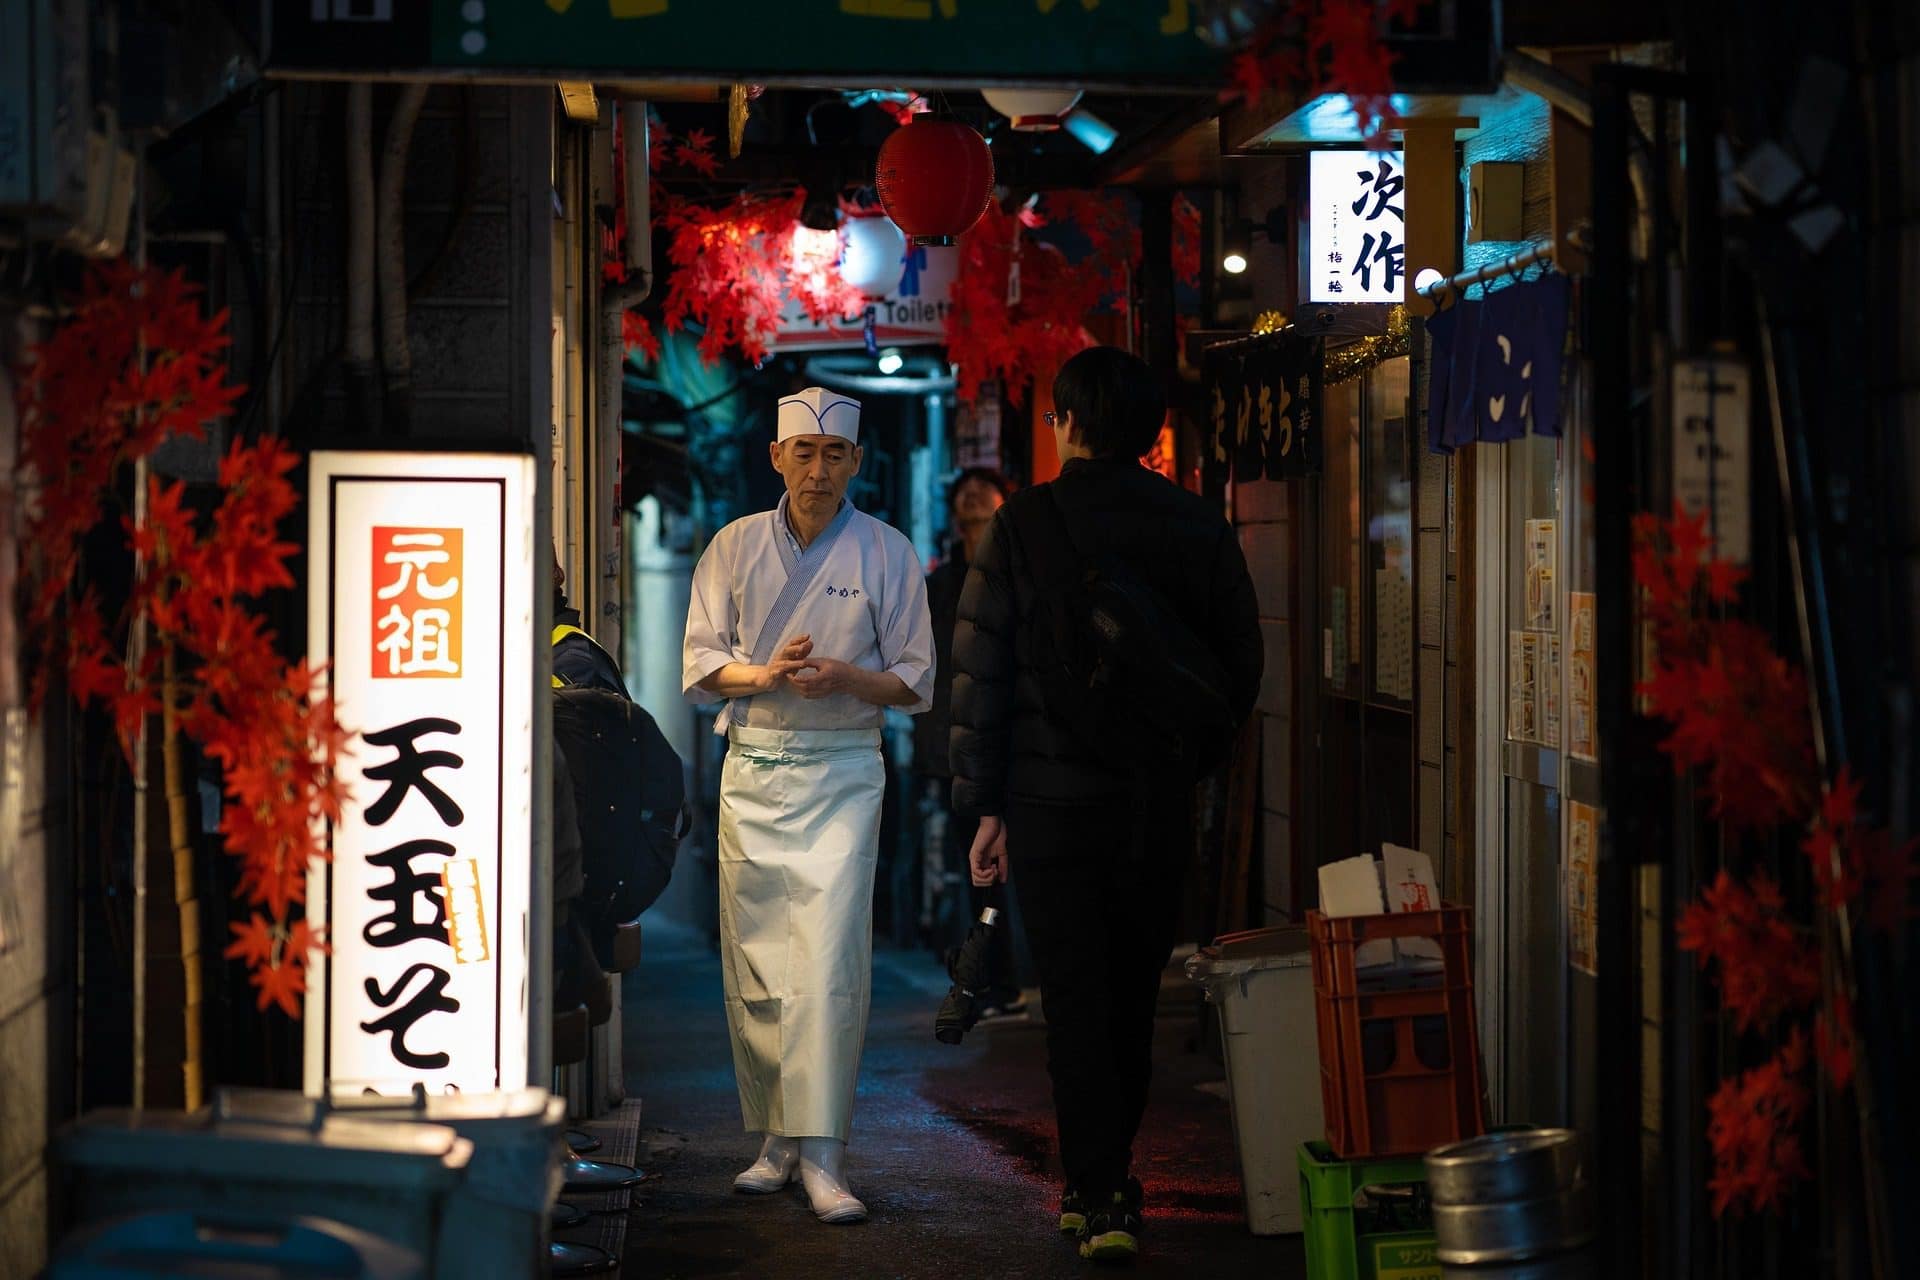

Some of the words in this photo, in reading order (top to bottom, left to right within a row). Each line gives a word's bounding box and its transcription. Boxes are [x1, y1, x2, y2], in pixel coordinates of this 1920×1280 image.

[1352, 160, 1404, 293] 次作
[884, 300, 957, 323] Toilet
[376, 531, 461, 677] 元祖
[826, 585, 860, 599] かめや
[360, 716, 465, 1096] 天玉そ
[1397, 1247, 1438, 1265] サント
